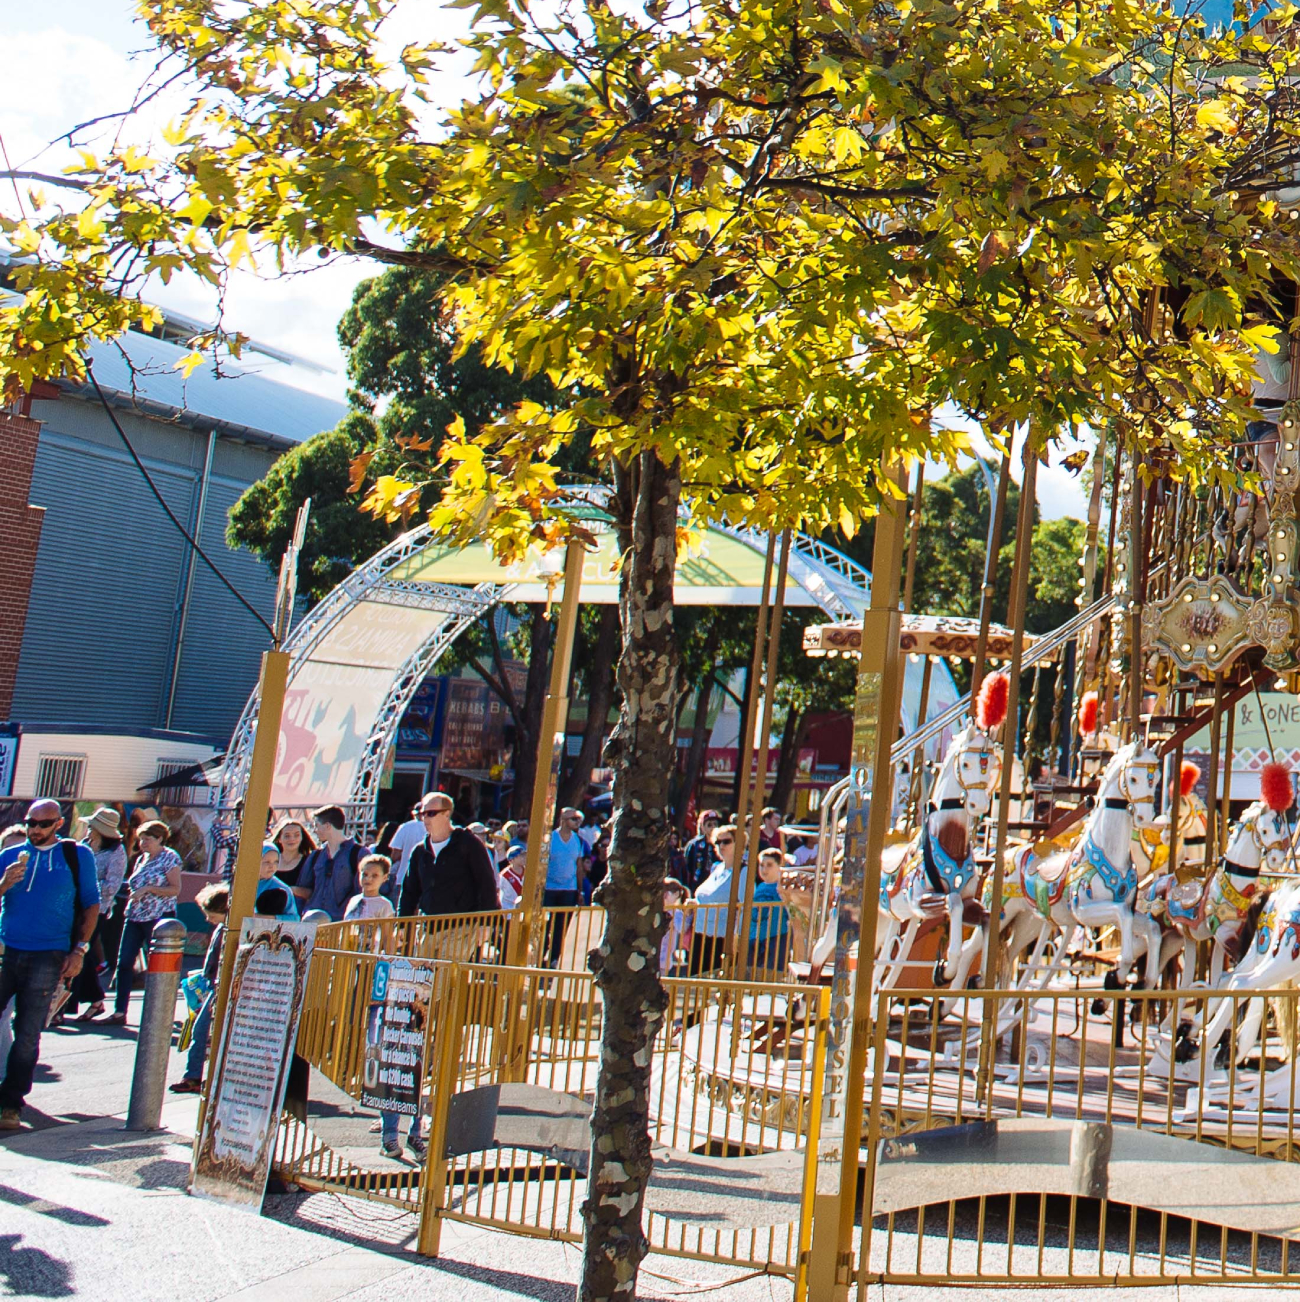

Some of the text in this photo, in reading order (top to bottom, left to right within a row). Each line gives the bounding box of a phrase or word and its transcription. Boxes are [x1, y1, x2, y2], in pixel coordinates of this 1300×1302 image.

[1241, 703, 1253, 725] &
[828, 930, 855, 1118] CAROUSEL
[362, 1092, 418, 1115] #carouseldreams
